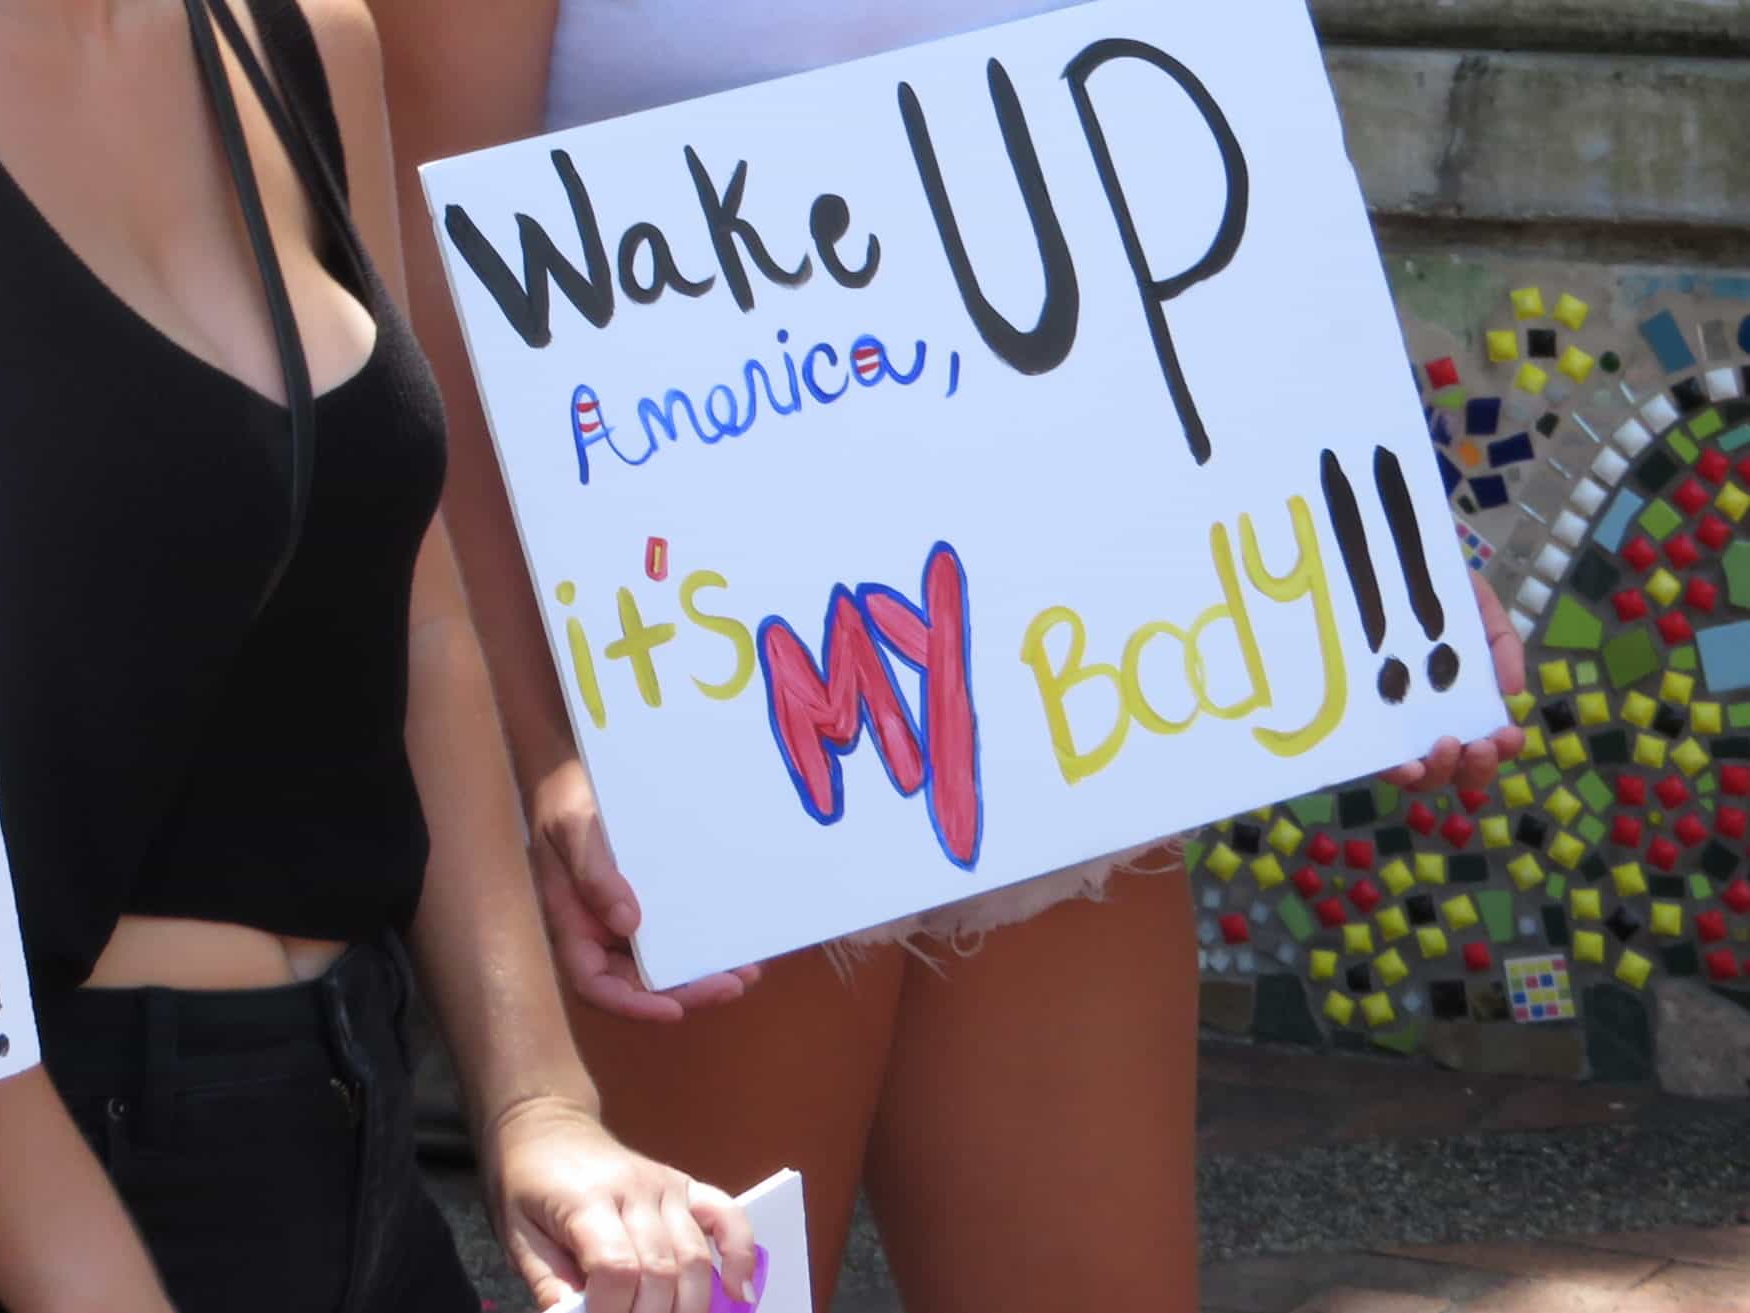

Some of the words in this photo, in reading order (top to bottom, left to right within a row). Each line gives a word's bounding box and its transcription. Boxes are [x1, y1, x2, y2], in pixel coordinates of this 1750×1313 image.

[444, 145, 881, 350] Wake
[897, 36, 1250, 466] UP
[570, 329, 960, 484] America,
[757, 540, 983, 872] MY
